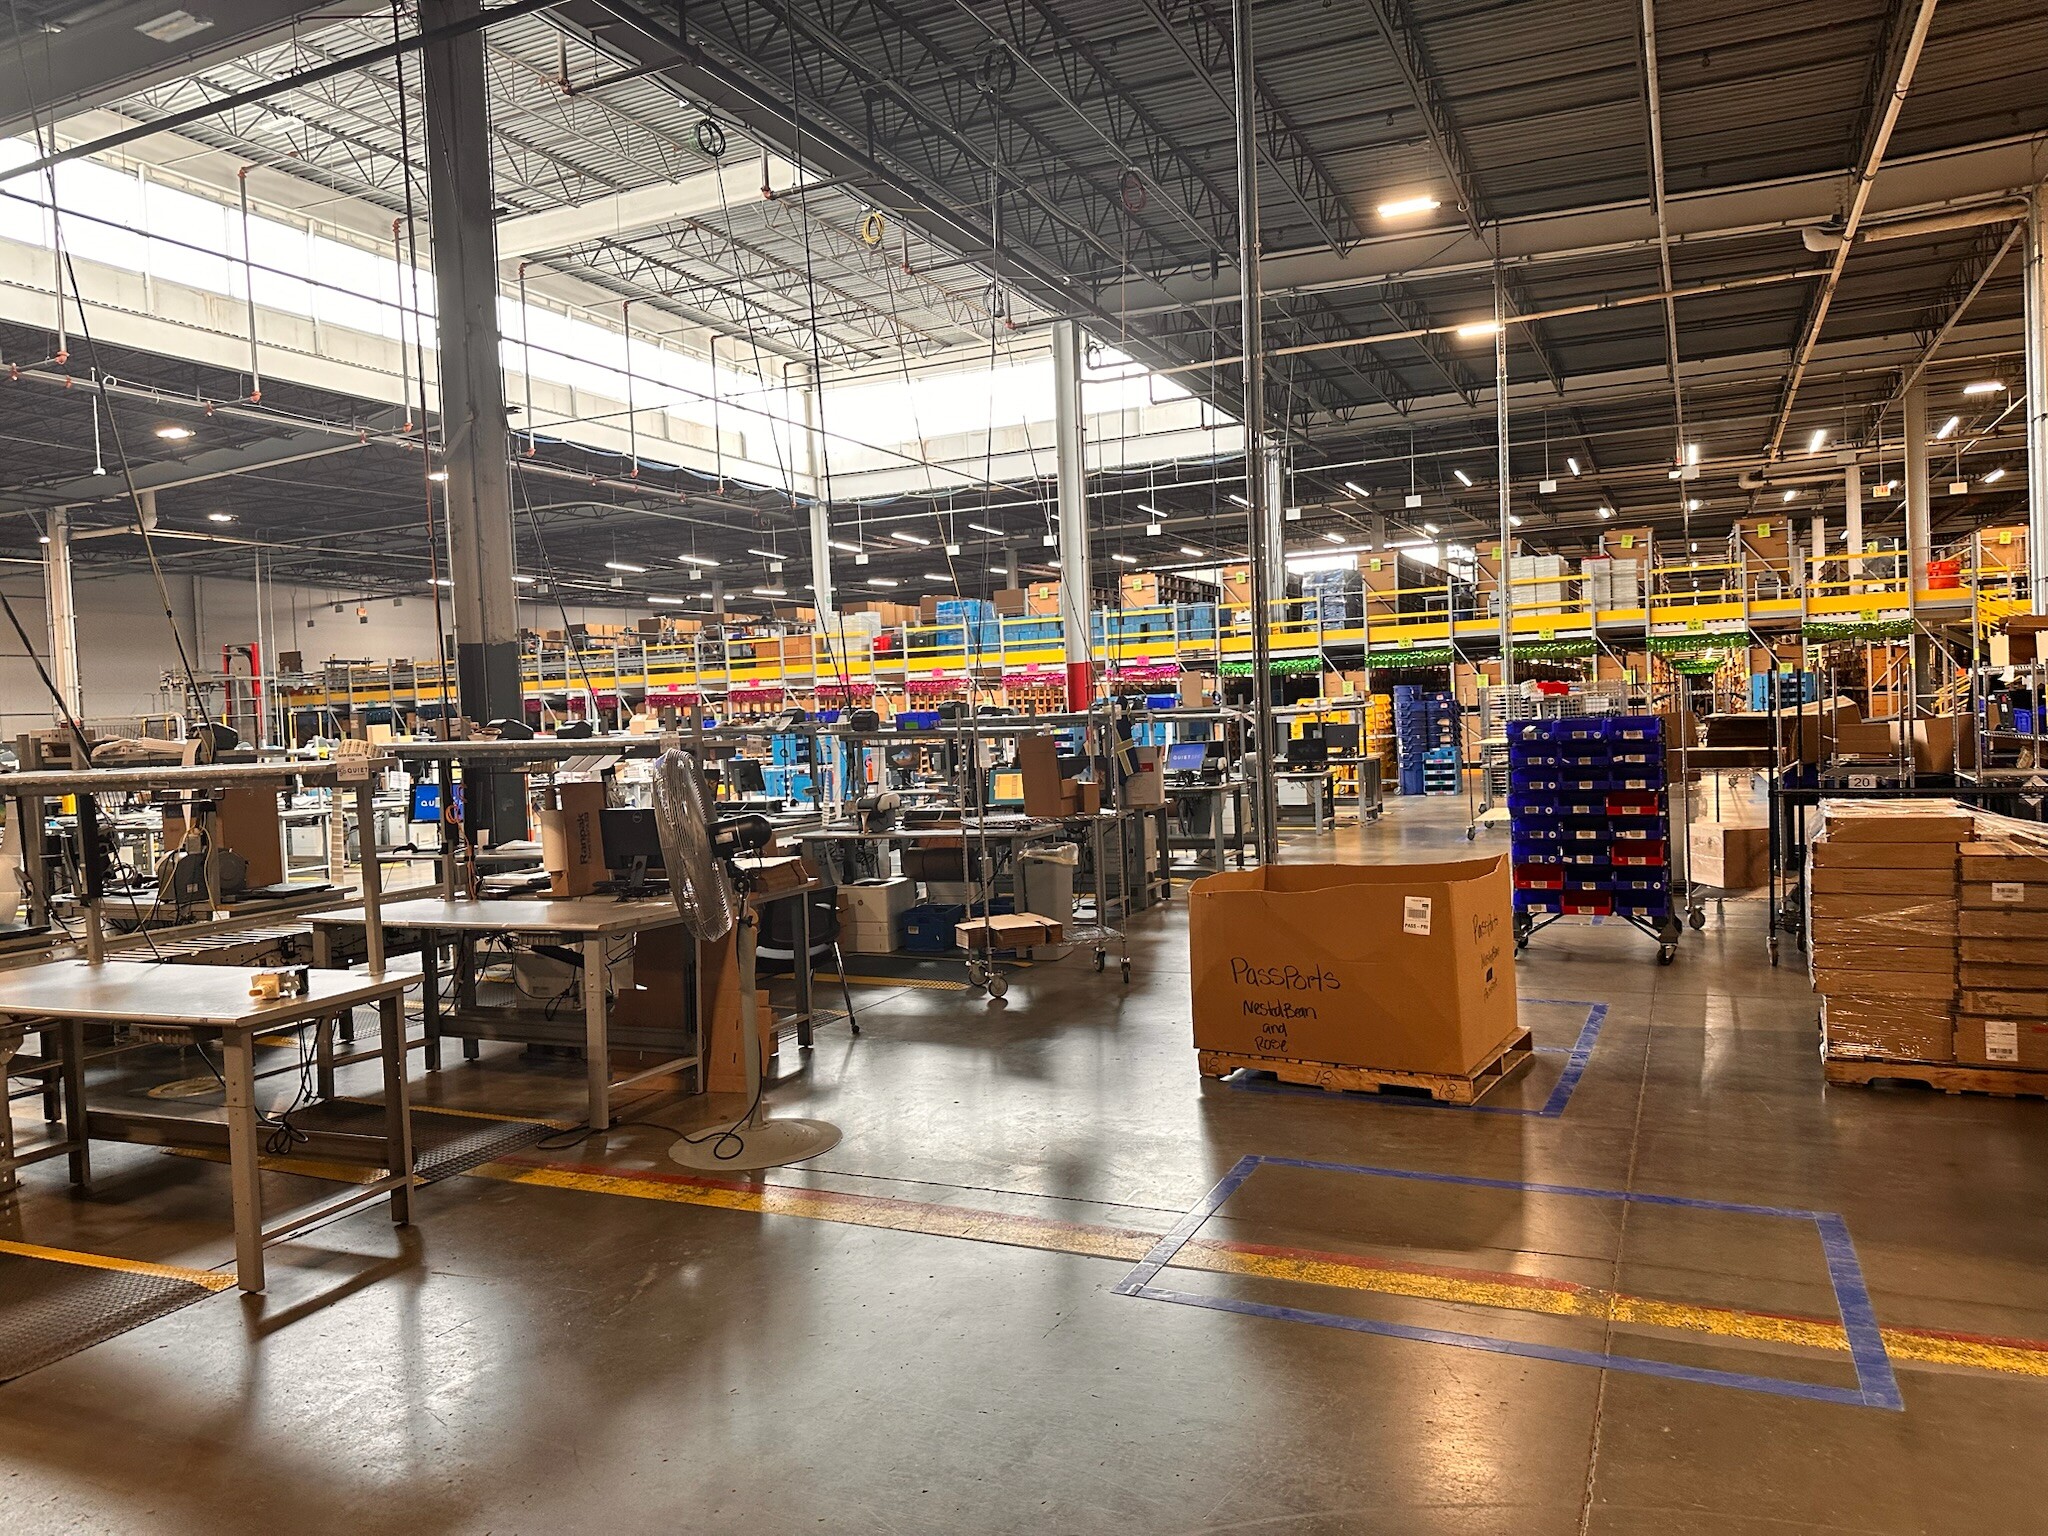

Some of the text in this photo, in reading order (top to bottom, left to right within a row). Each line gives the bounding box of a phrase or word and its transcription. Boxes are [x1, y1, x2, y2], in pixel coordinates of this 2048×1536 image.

[1854, 777, 1870, 787] 20
[577, 813, 588, 865] Ranpak
[1262, 1023, 1288, 1037] and
[1255, 1036, 1288, 1052] Rose
[1315, 1070, 1333, 1085] 18
[1439, 1083, 1457, 1099] 18
